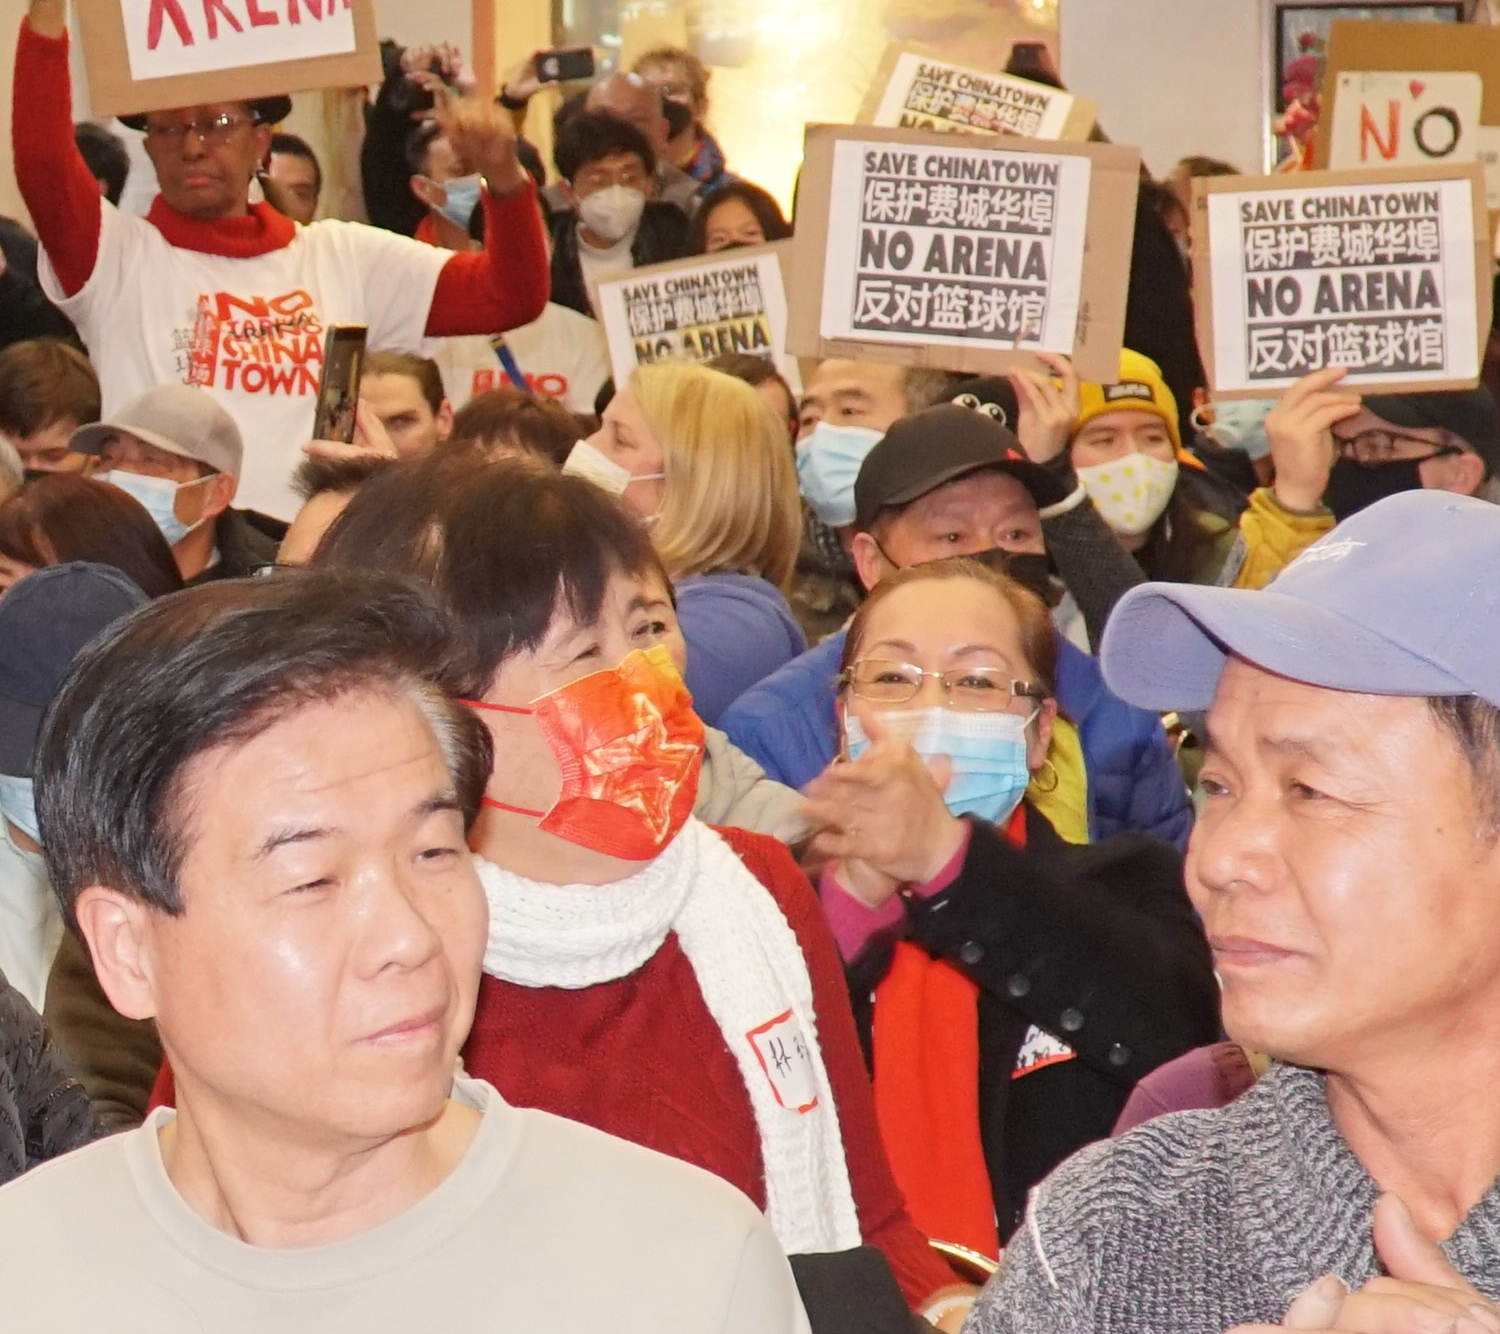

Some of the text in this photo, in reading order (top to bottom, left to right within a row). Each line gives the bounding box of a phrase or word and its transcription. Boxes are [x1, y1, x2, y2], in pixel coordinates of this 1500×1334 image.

[1360, 100, 1461, 161] NO
[864, 150, 1059, 187] SAVE CHINATOWN
[864, 179, 1052, 234] 保护费城华埠
[1241, 191, 1439, 223] SAVE CHINATOWN
[860, 228, 1047, 282] NO ARENA
[1245, 219, 1440, 269] 保护费城华埠
[215, 290, 314, 321] NO
[622, 264, 759, 302] SAVE CHINATOWN
[854, 279, 1045, 336] 反对篮球馆
[1247, 269, 1441, 318] NO ARENA
[683, 320, 770, 361] ARENA
[1249, 322, 1443, 372] 反对篮球馆
[222, 359, 320, 397] TOWN
